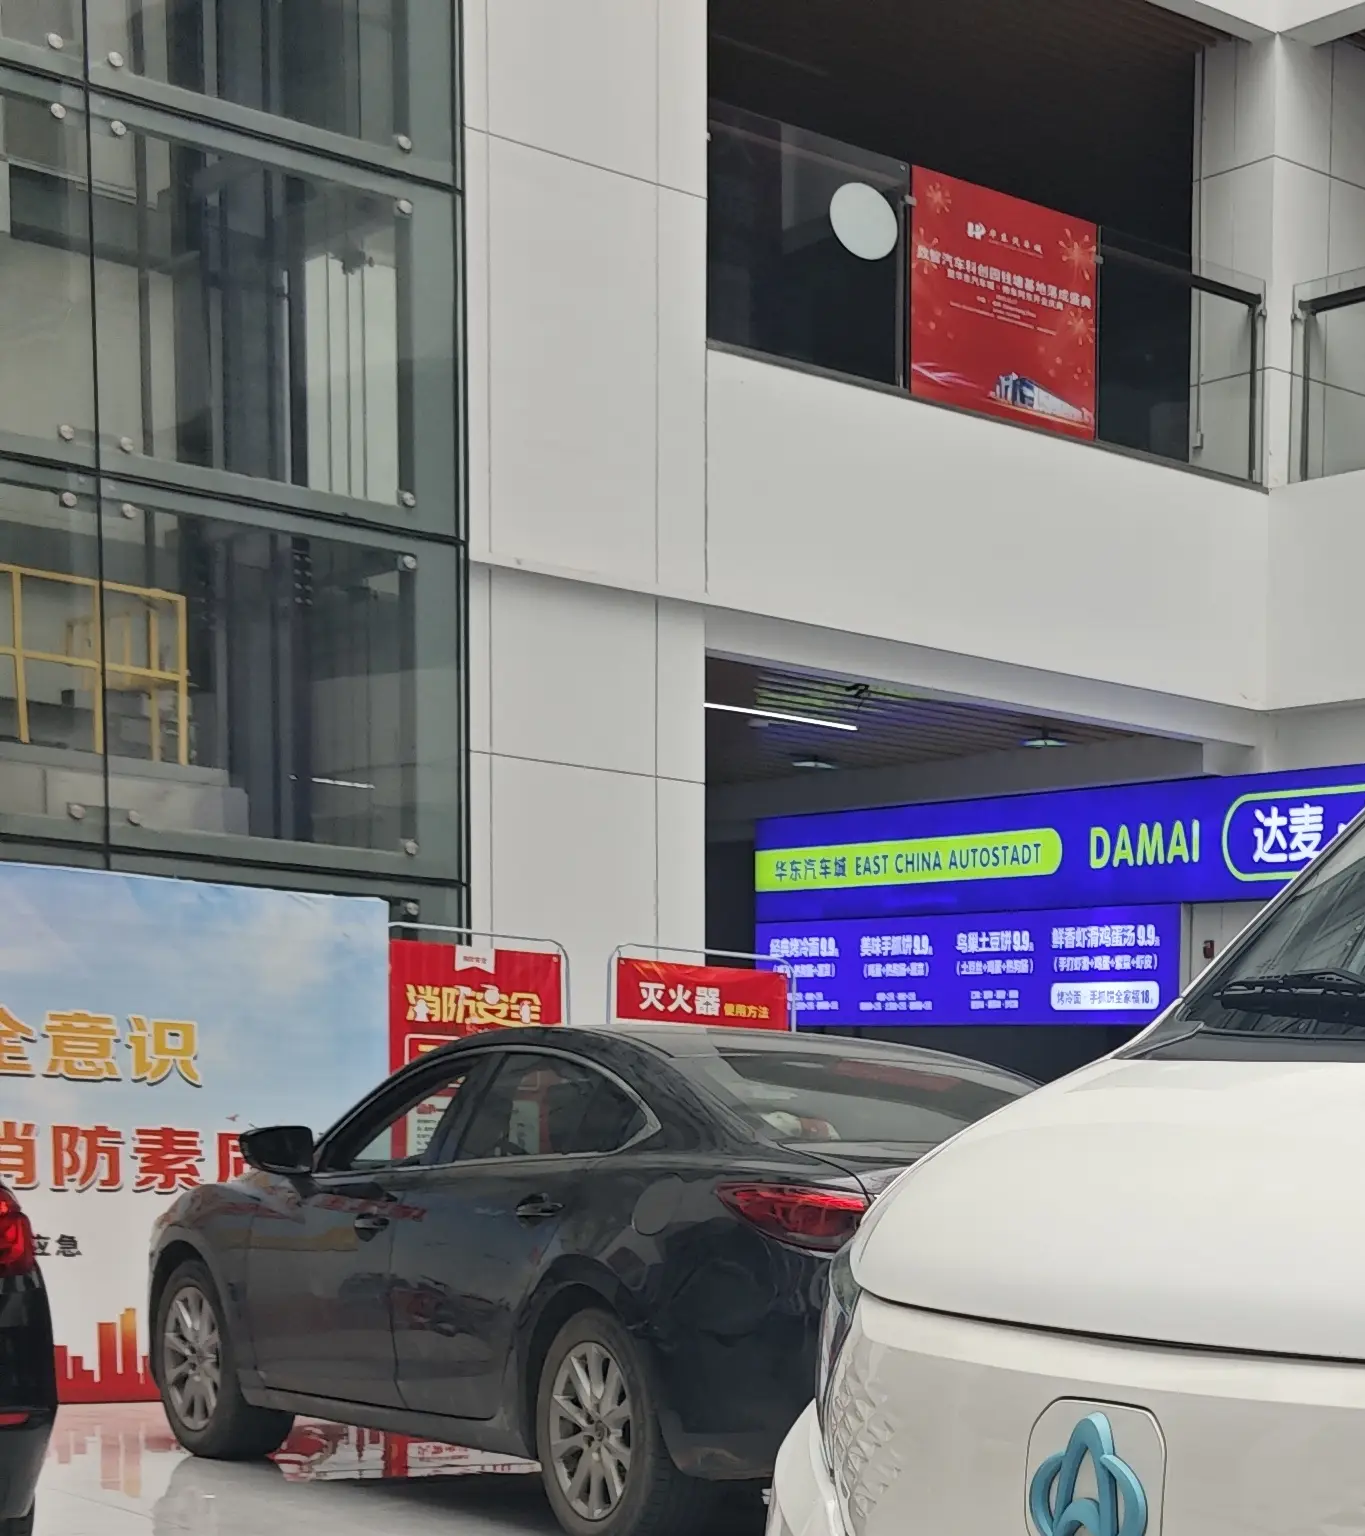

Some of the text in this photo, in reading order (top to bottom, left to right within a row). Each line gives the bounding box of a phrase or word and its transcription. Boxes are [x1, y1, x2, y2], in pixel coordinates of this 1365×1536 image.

[774, 843, 1042, 882] 华东汽车城 EAST CHINA AUTOSTADT
[1089, 818, 1200, 869] DAMAI
[405, 983, 542, 1028] 消防安全
[639, 981, 770, 1019] 灭火器 使用方法
